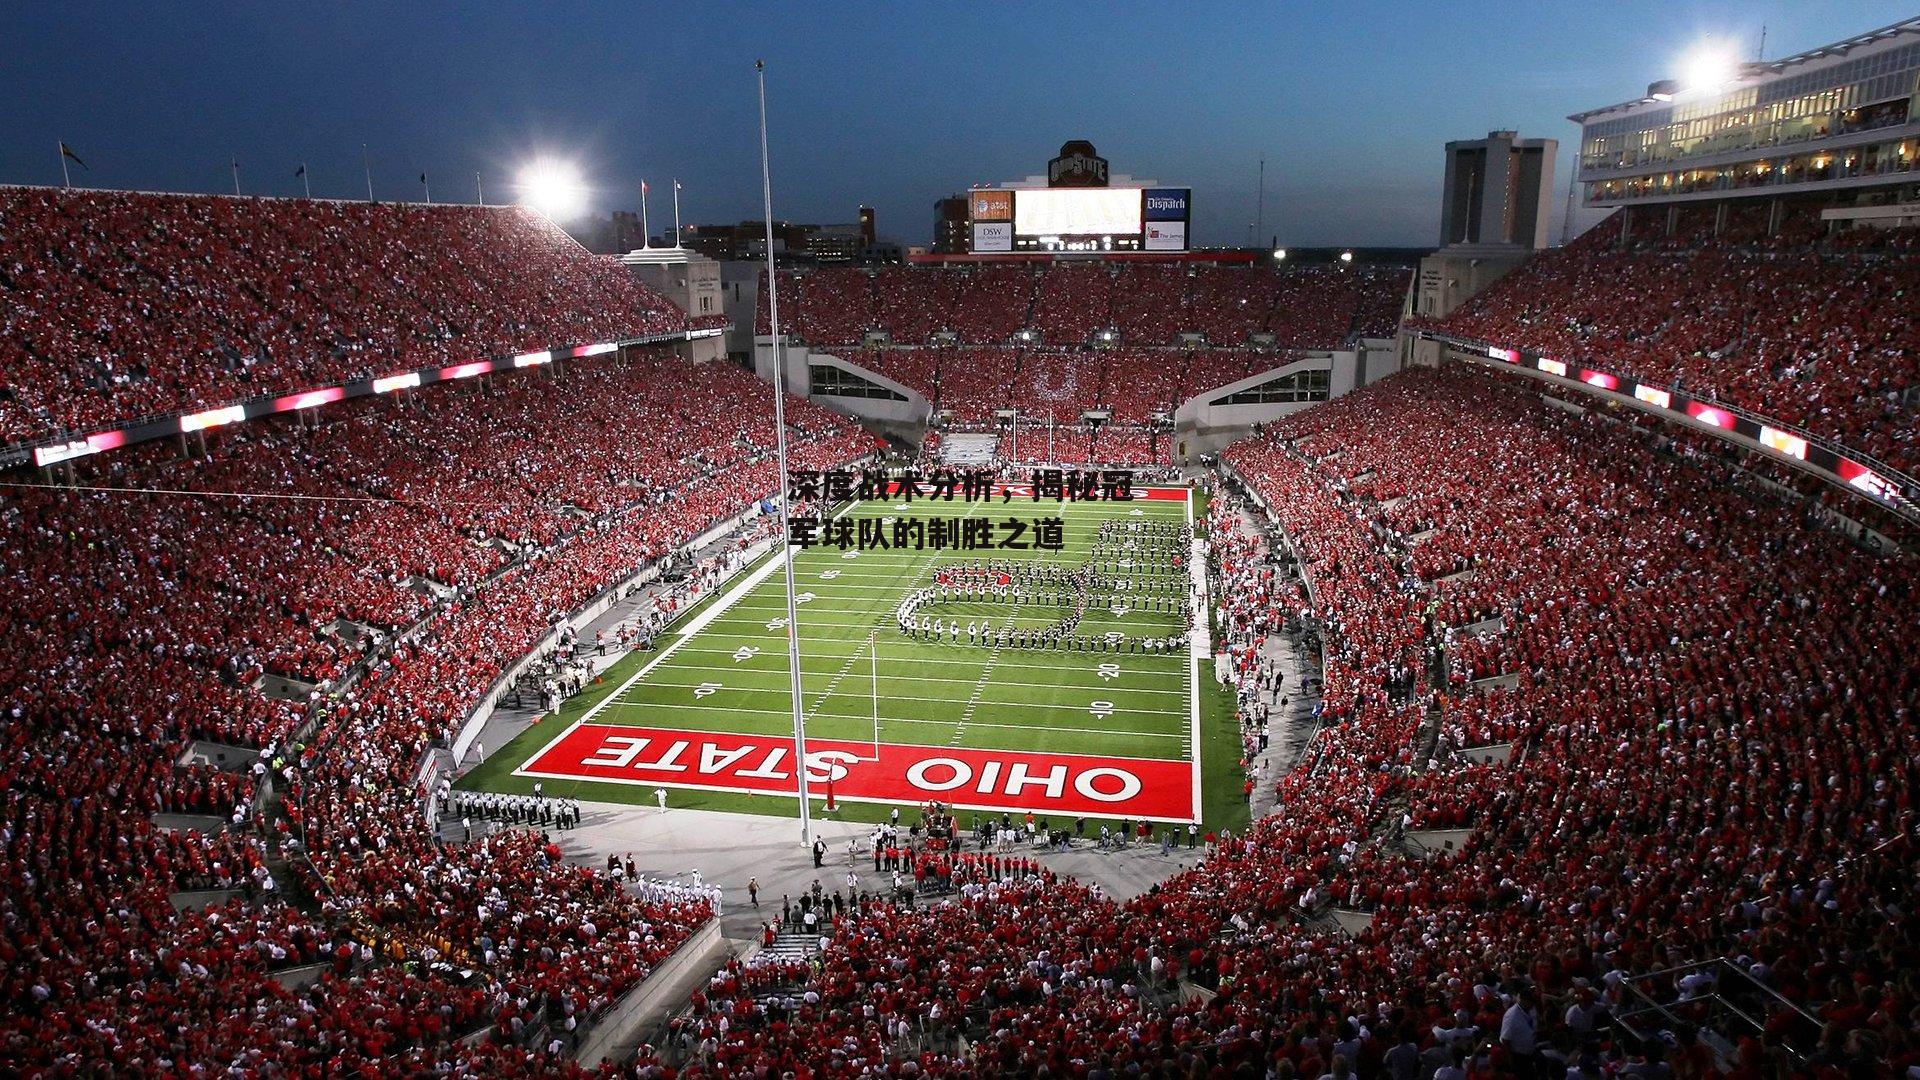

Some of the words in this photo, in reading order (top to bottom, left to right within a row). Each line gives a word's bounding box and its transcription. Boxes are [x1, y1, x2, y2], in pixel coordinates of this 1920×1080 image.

[1147, 197, 1186, 211] Dispatch
[983, 228, 1003, 236] DSW
[1097, 663, 1120, 678] 20
[693, 682, 723, 696] 10
[1089, 701, 1114, 714] 10
[580, 736, 859, 783] STATE
[905, 757, 1142, 802] OHIO
